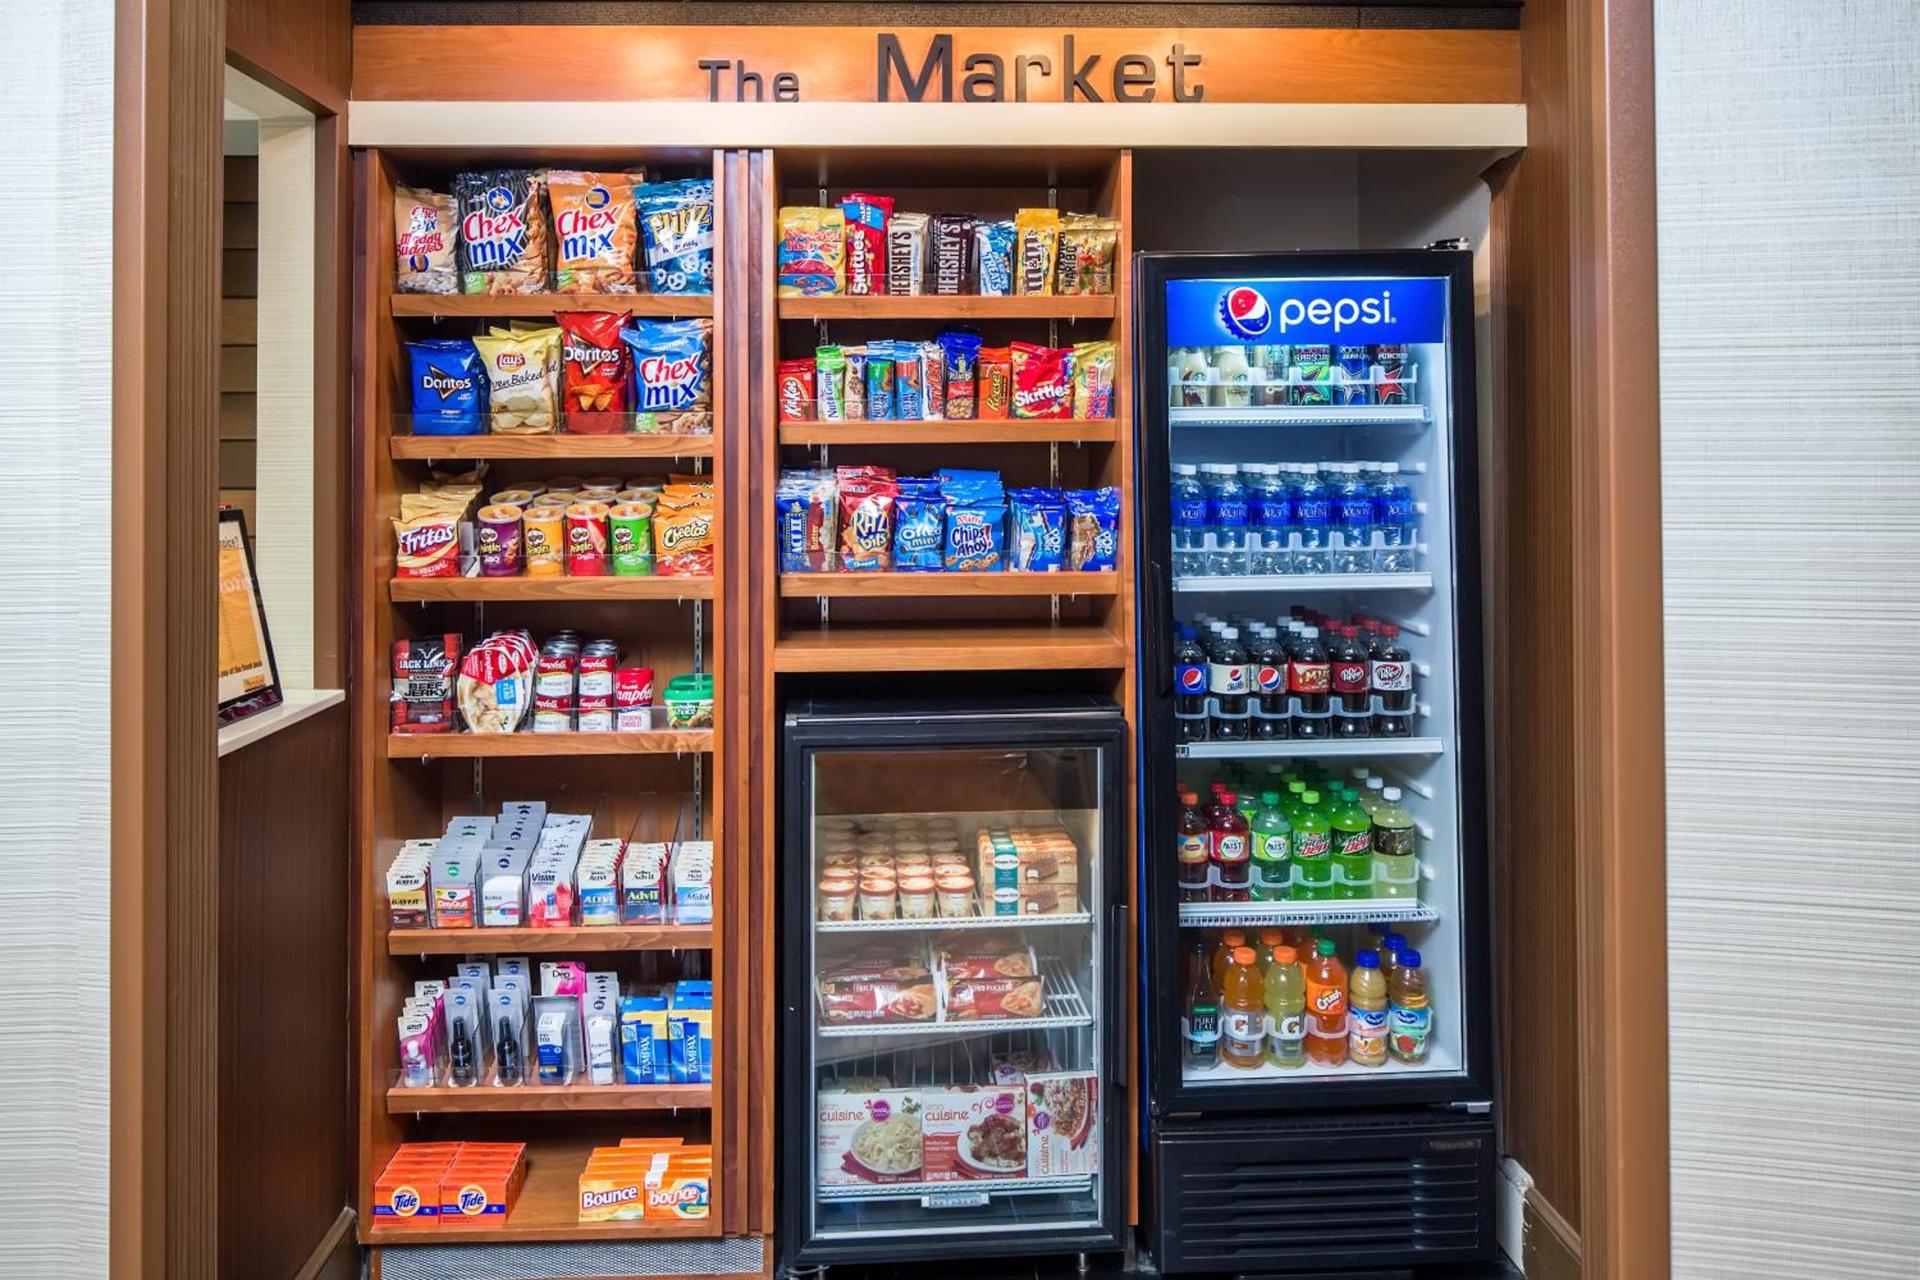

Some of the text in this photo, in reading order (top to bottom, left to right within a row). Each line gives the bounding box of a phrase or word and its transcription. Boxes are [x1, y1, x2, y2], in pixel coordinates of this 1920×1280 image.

[699, 33, 1204, 102] The Market
[464, 207, 523, 242] Chex
[557, 205, 619, 237] Chex
[471, 229, 525, 267] mix
[564, 228, 614, 260] mix
[853, 231, 868, 294] Skittles
[891, 231, 912, 296] HERSHEY'S
[938, 224, 961, 294] HERSHEY'S
[1063, 245, 1077, 288] HARIBO
[1279, 290, 1390, 334] pepsi
[564, 346, 620, 363] Doritos
[510, 370, 544, 386] Baked
[640, 353, 700, 384] Chex
[423, 375, 472, 390] Doritos
[645, 375, 699, 407] mix
[1015, 383, 1071, 408] Skittles
[663, 521, 709, 548] Cheetos
[853, 512, 888, 537] RITZ
[951, 526, 985, 546] Chips
[400, 525, 456, 556] Fritos
[858, 532, 888, 550] bits
[404, 688, 449, 698] JERKY
[408, 681, 444, 691] BEEF
[627, 890, 660, 901] Advil
[1316, 990, 1343, 1011] Crush
[641, 1035, 651, 1077] TAMPAX
[688, 1034, 698, 1075] TAMPAX
[820, 1110, 865, 1122] cuisine
[925, 1110, 970, 1122] cuisine
[1041, 1135, 1049, 1175] cuisine
[394, 1195, 418, 1212] Tide
[460, 1192, 485, 1209] Tide
[582, 1186, 638, 1210] Bounce
[650, 1187, 698, 1207] bounce
